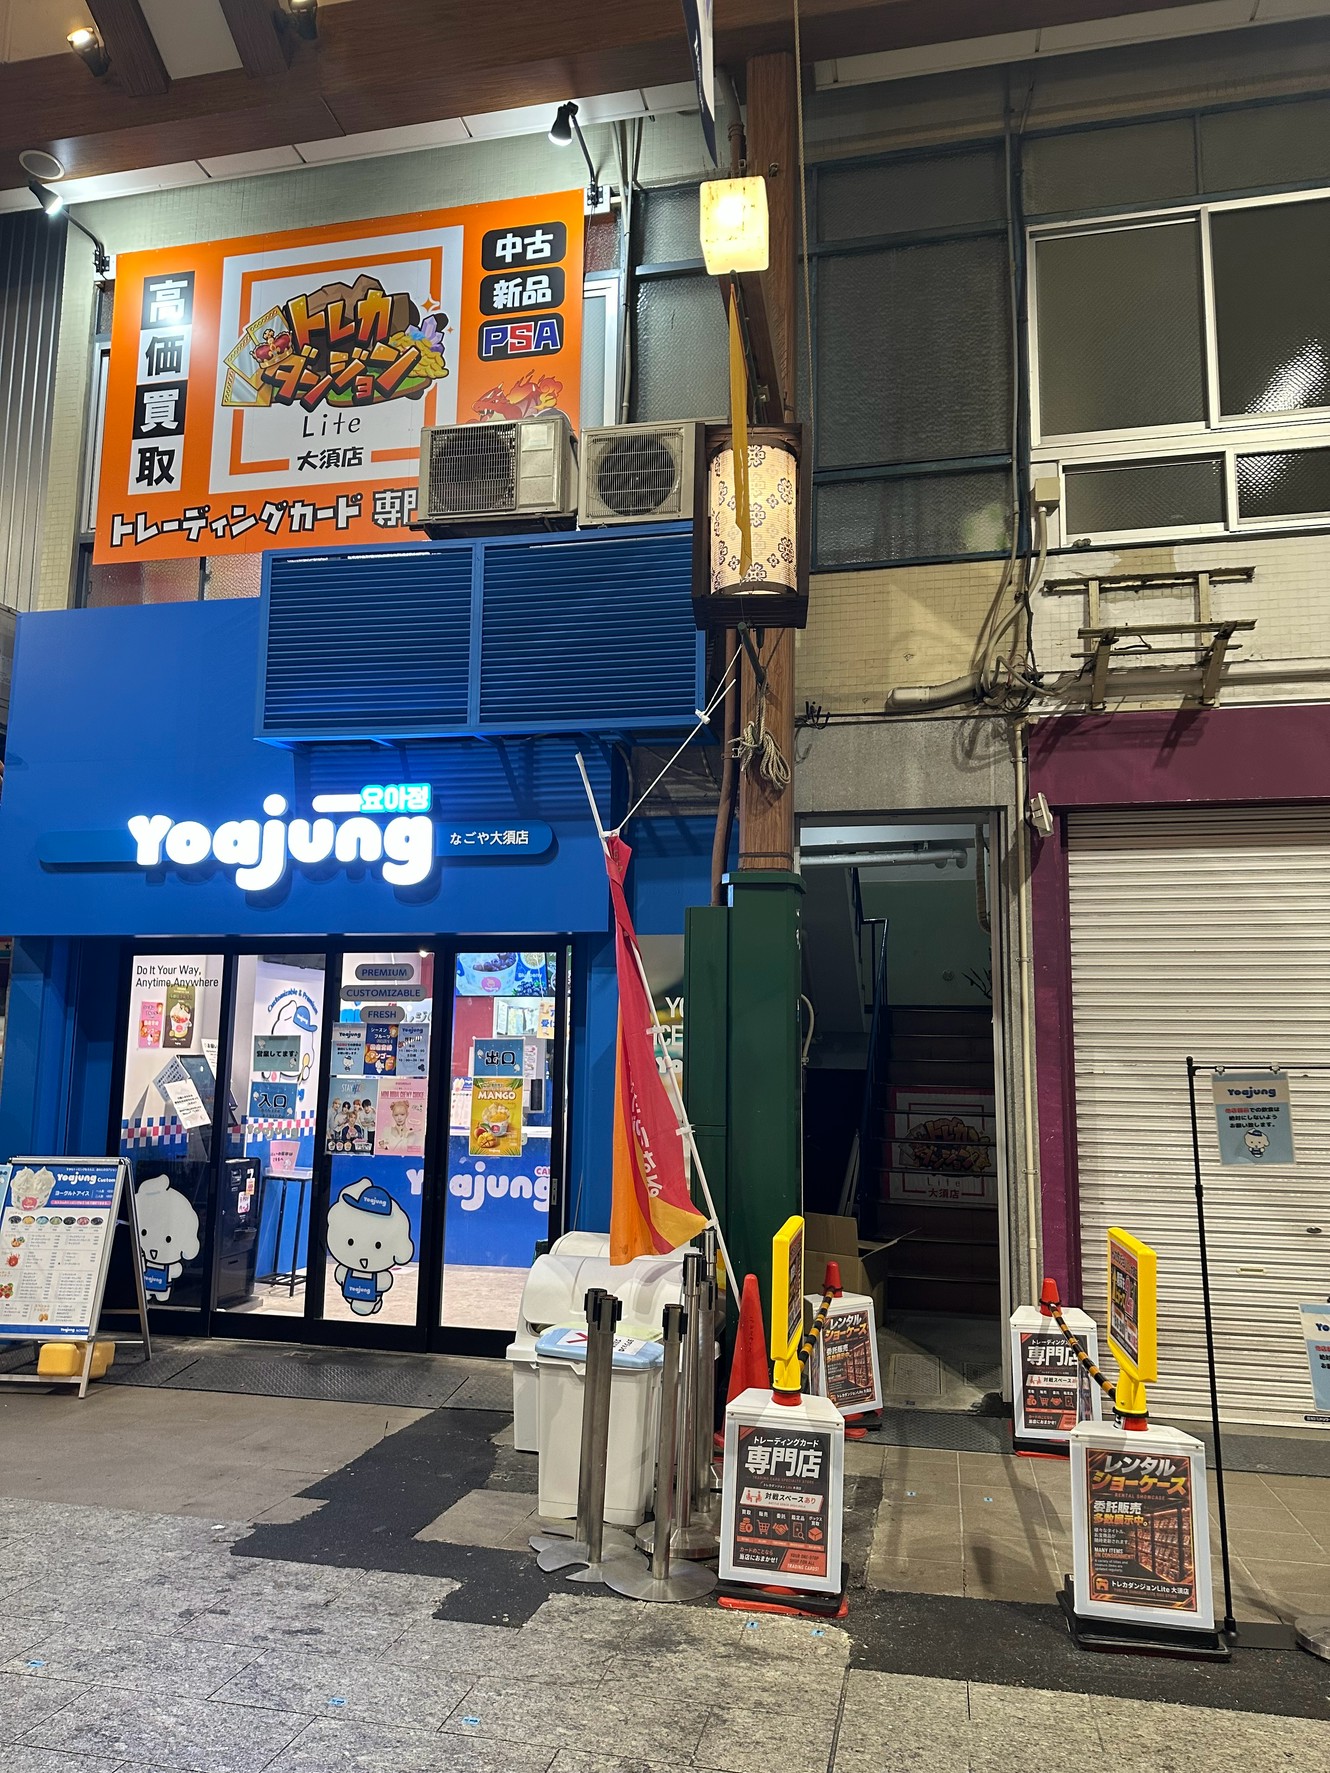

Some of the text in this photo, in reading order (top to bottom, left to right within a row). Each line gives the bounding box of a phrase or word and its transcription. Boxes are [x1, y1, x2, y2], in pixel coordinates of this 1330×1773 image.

[494, 229, 554, 264] 中古
[492, 275, 553, 311] 新品
[287, 290, 395, 346] トレカ
[482, 319, 560, 356] PSA
[134, 279, 188, 488] 高価買取
[272, 345, 421, 409] ダンジョン
[303, 412, 361, 439] Lite
[297, 446, 363, 472] 大須店
[110, 493, 363, 548] トレーディングカード
[359, 783, 431, 813] 요아정
[127, 793, 433, 892] Yoajung
[449, 829, 529, 847] なごや大須店
[136, 965, 202, 977] Do It Your Way,
[361, 968, 407, 977] PREMIUM
[346, 988, 421, 998] CUSTOMIZABLE
[367, 1010, 397, 1019] FRESH
[484, 1049, 516, 1066] 出口
[477, 1090, 517, 1100] MANGO
[1227, 1086, 1277, 1099] Yoajung
[258, 1093, 288, 1109] 入口
[56, 1171, 97, 1186] Yoajung
[363, 1195, 387, 1208] Yoajung
[928, 1188, 960, 1199] 大須店
[348, 1284, 371, 1296] Yoajung
[831, 1314, 862, 1330] レンタル
[824, 1323, 868, 1342] ショーケース
[753, 1436, 820, 1448] トレーディングカード
[744, 1445, 823, 1480] 専門店
[1104, 1455, 1176, 1477] レンタル
[1092, 1471, 1187, 1497] ショーケース
[764, 1493, 817, 1505] 対戦スペースあり
[1093, 1500, 1143, 1515] 委託販売
[1093, 1513, 1149, 1527] 多数展示中。
[739, 1554, 778, 1564] 当店におまかせ!
[1111, 1580, 1170, 1594] トレカダンジョンLite
